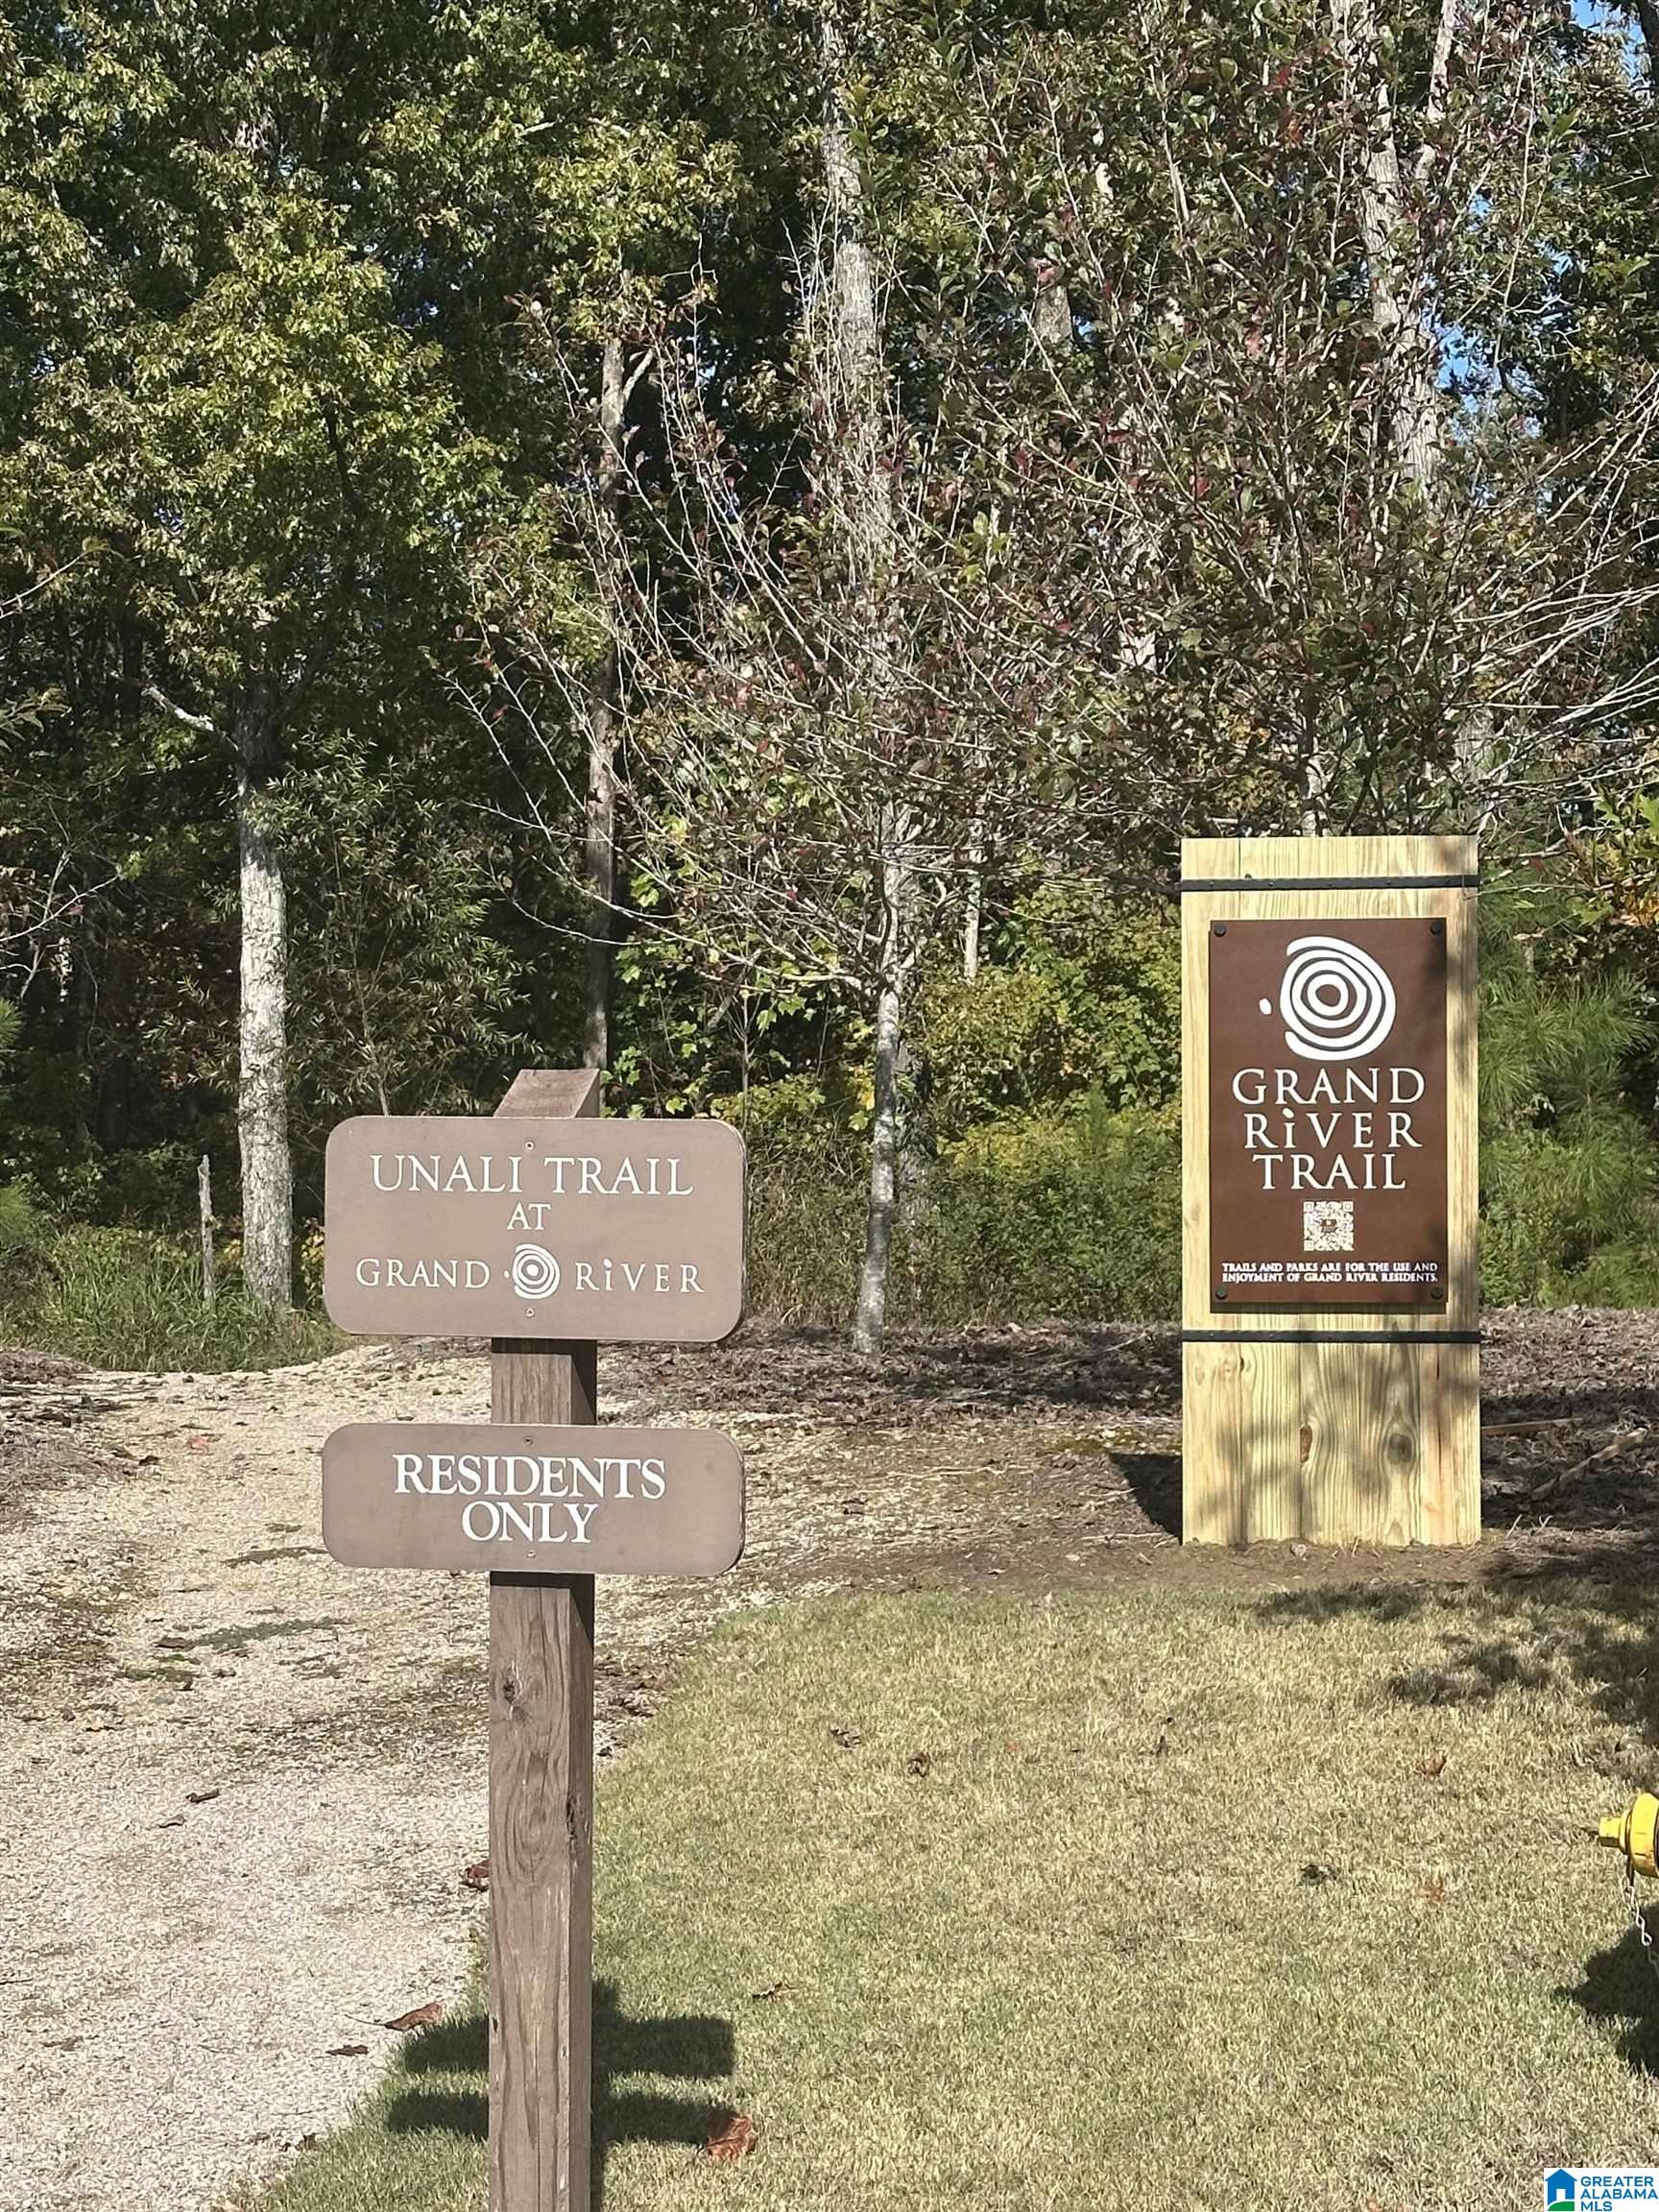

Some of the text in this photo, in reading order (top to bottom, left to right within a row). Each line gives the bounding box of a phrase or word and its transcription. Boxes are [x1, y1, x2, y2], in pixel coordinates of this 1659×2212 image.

[1232, 1068, 1426, 1105] GRAND
[370, 1154, 693, 1196] UNALI TRAIL
[1252, 1153, 1407, 1190] TRAIL
[507, 1203, 551, 1231] AT
[356, 1259, 491, 1289] GRAND
[1221, 1262, 1438, 1272] TRAILS AND PARKS ARE FOR THE USE AND
[1222, 1273, 1438, 1284] ENJOYMENT OF GRAND RIVER RESIDENTS.
[392, 1454, 666, 1500] RESIDENTS
[462, 1502, 598, 1544] ONLY
